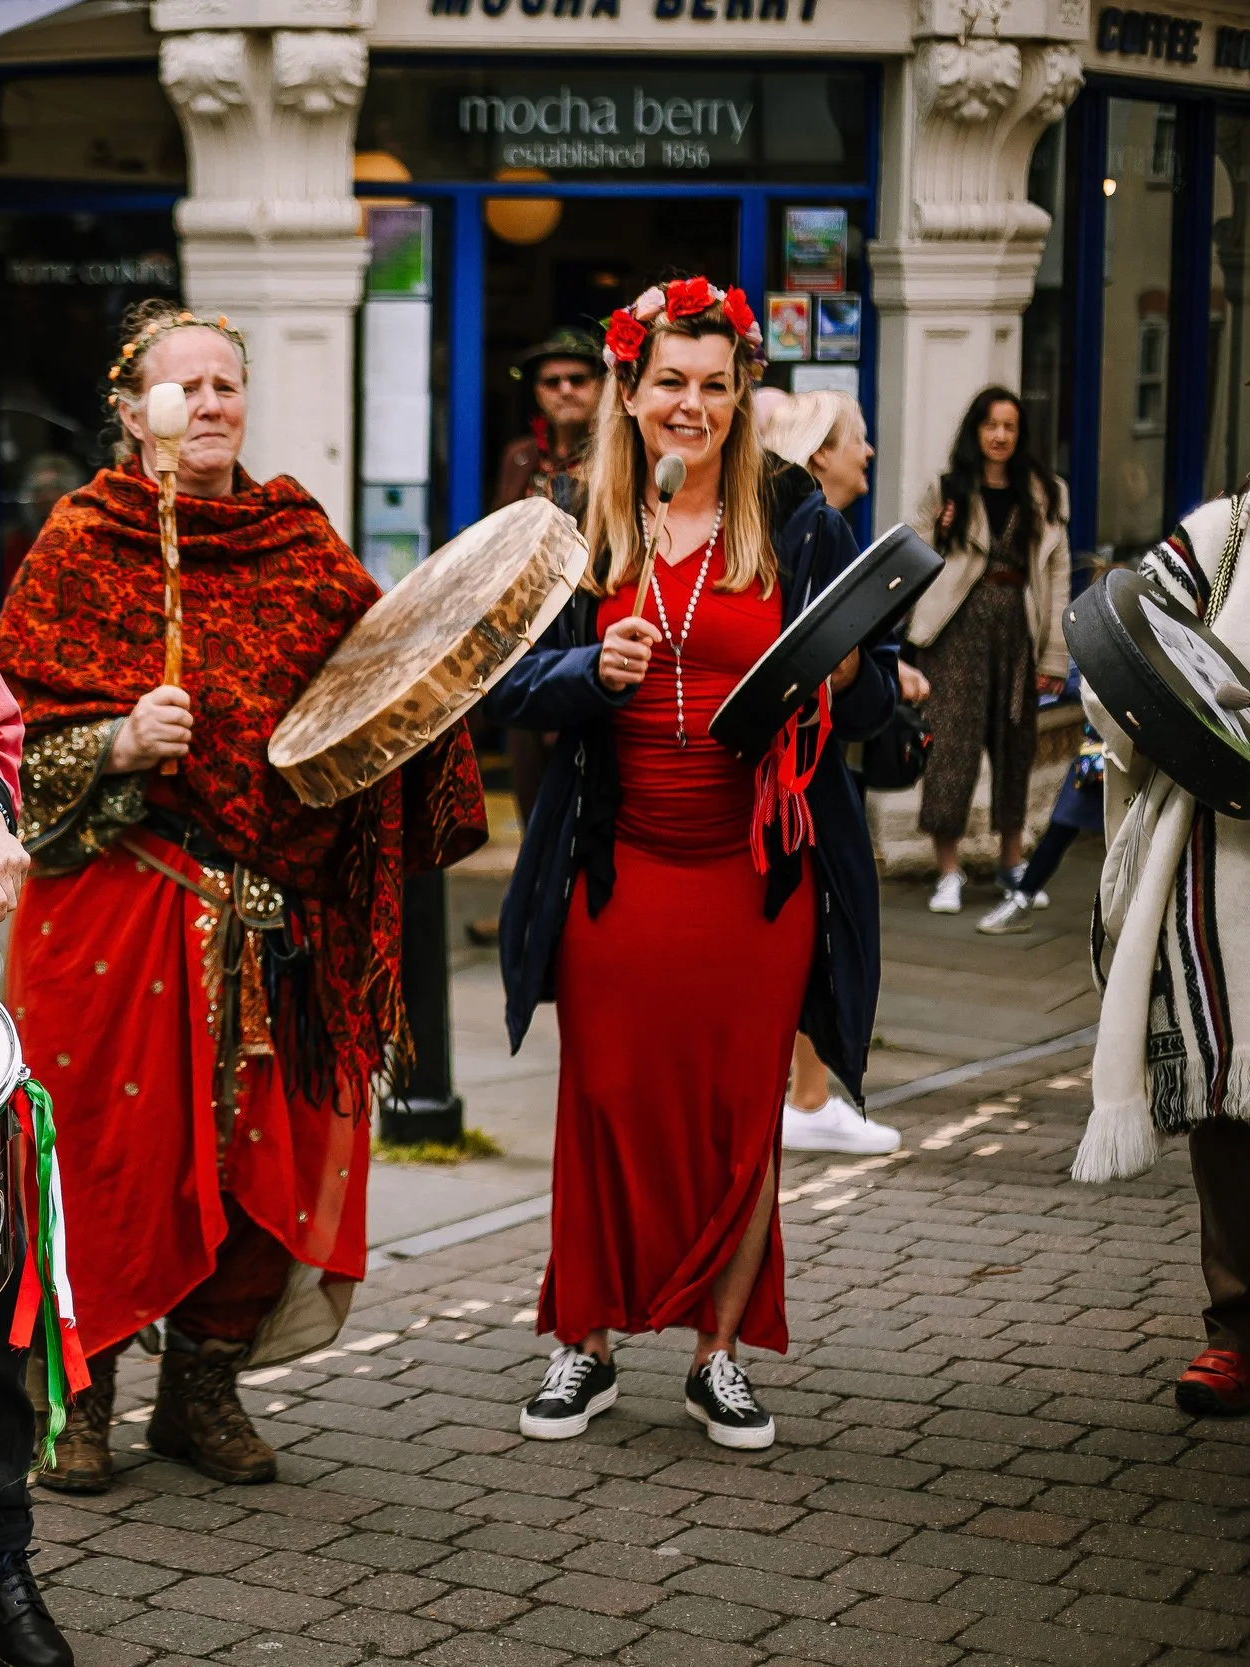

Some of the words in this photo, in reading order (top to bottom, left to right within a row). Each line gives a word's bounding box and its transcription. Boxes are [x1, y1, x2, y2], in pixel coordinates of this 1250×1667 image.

[459, 85, 619, 135] mocha
[634, 85, 754, 144] berry
[503, 138, 646, 168] established
